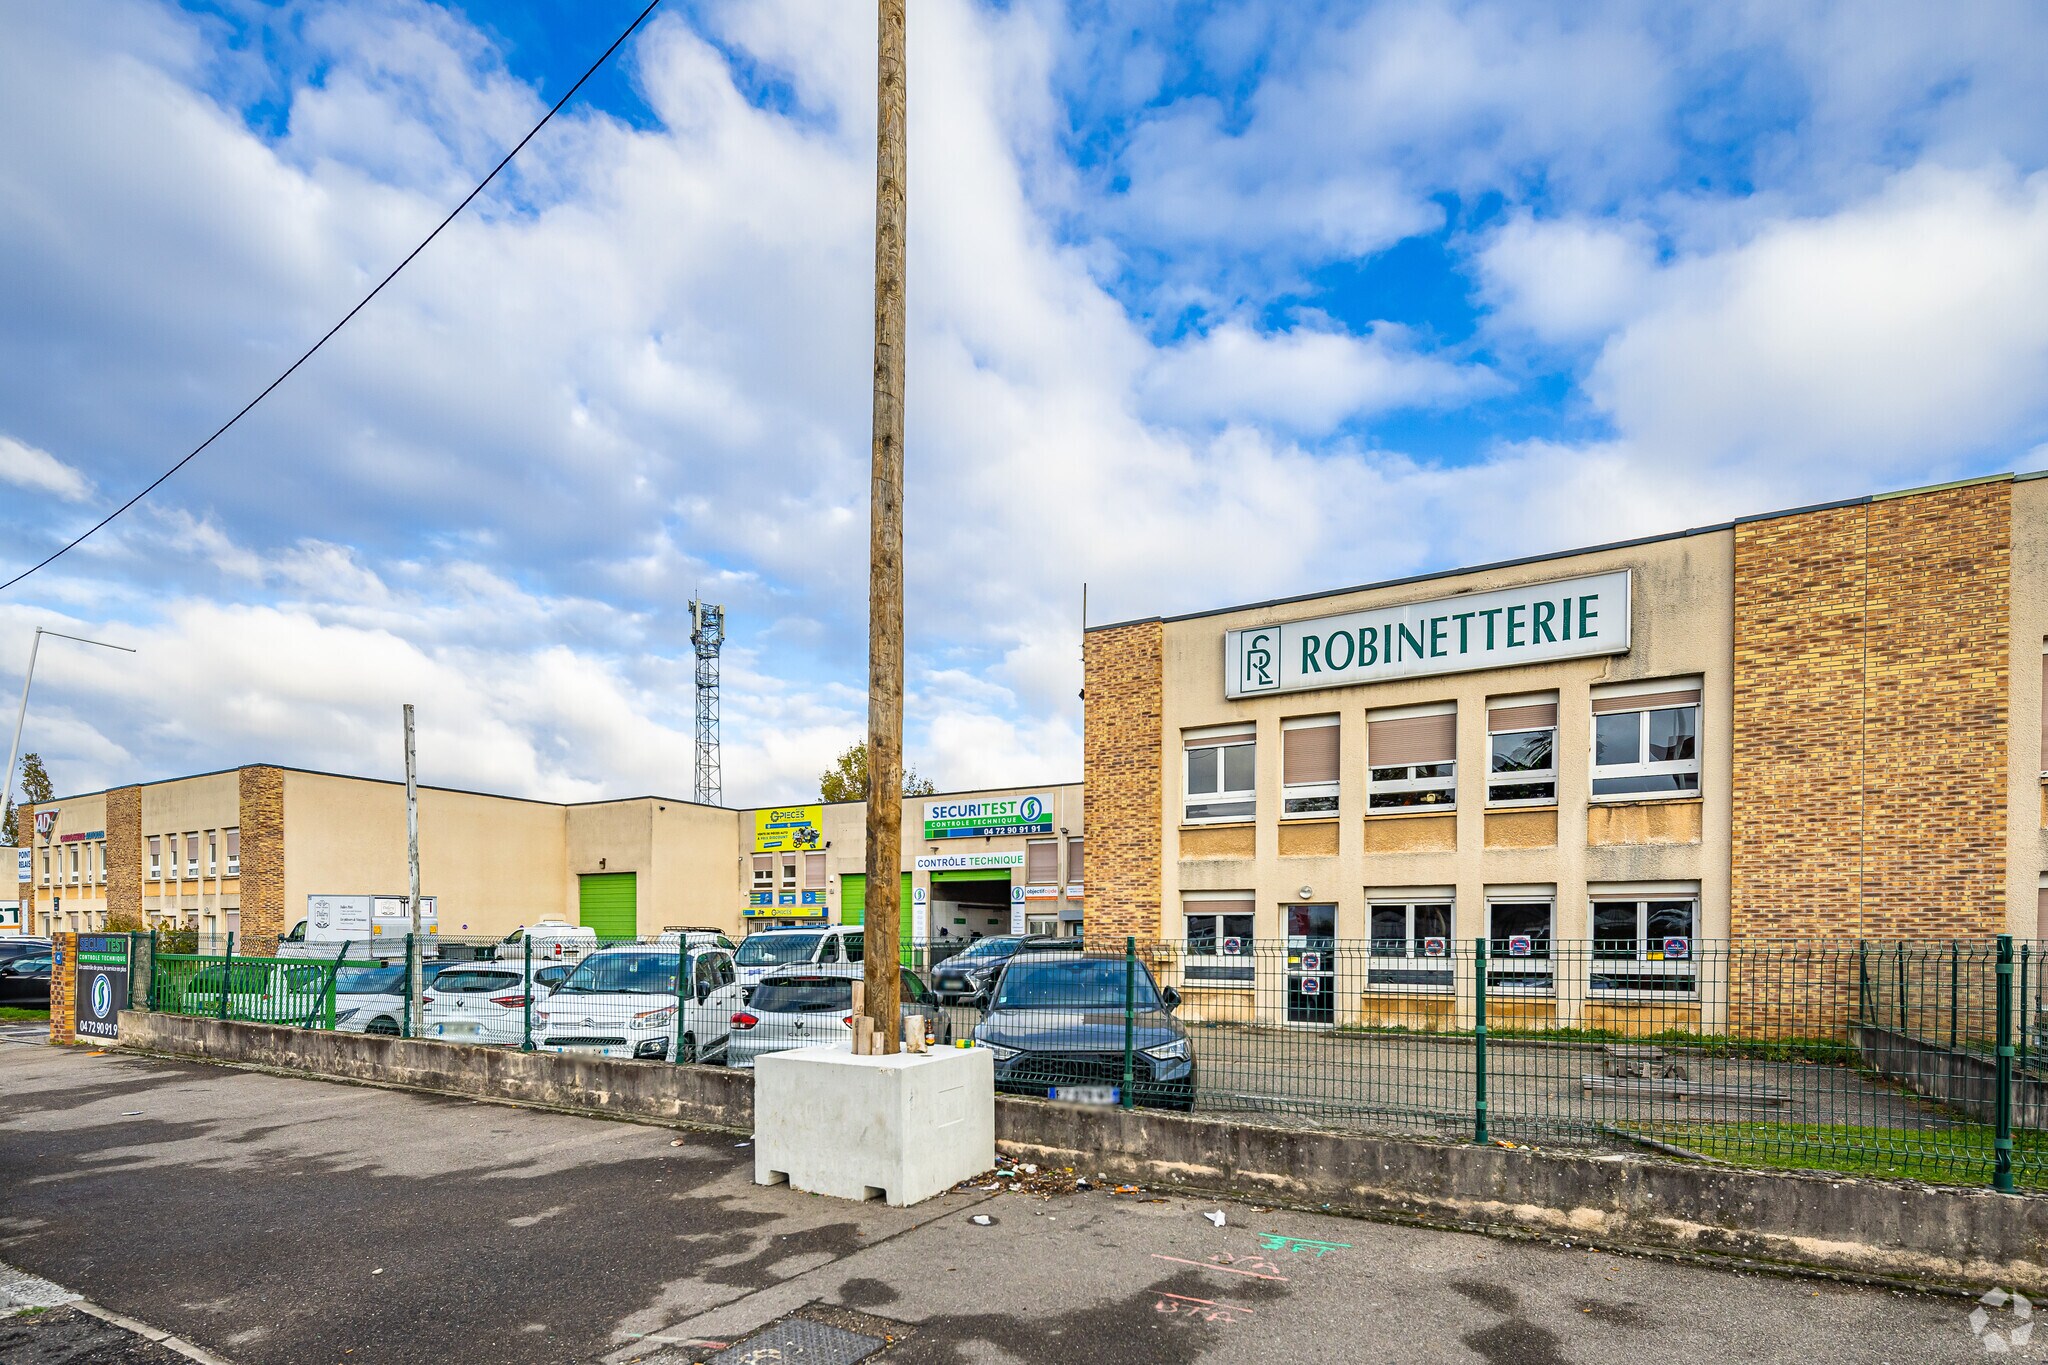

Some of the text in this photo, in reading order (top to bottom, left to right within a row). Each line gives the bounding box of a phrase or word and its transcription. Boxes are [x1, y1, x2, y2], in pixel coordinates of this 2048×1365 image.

[1301, 593, 1600, 675] ROBINETTERIE
[932, 801, 1018, 819] SECURITEST
[931, 820, 970, 828] CONTROLE
[1007, 826, 1017, 834] 90
[19, 860, 31, 868] RELAIS
[917, 855, 1024, 868] CONTRÔLE TECHNIQUE
[79, 938, 126, 952] SECURITEST
[80, 1020, 88, 1032] 04
[88, 1021, 96, 1033] 72
[96, 1022, 104, 1034] 90
[105, 1023, 112, 1035] 91
